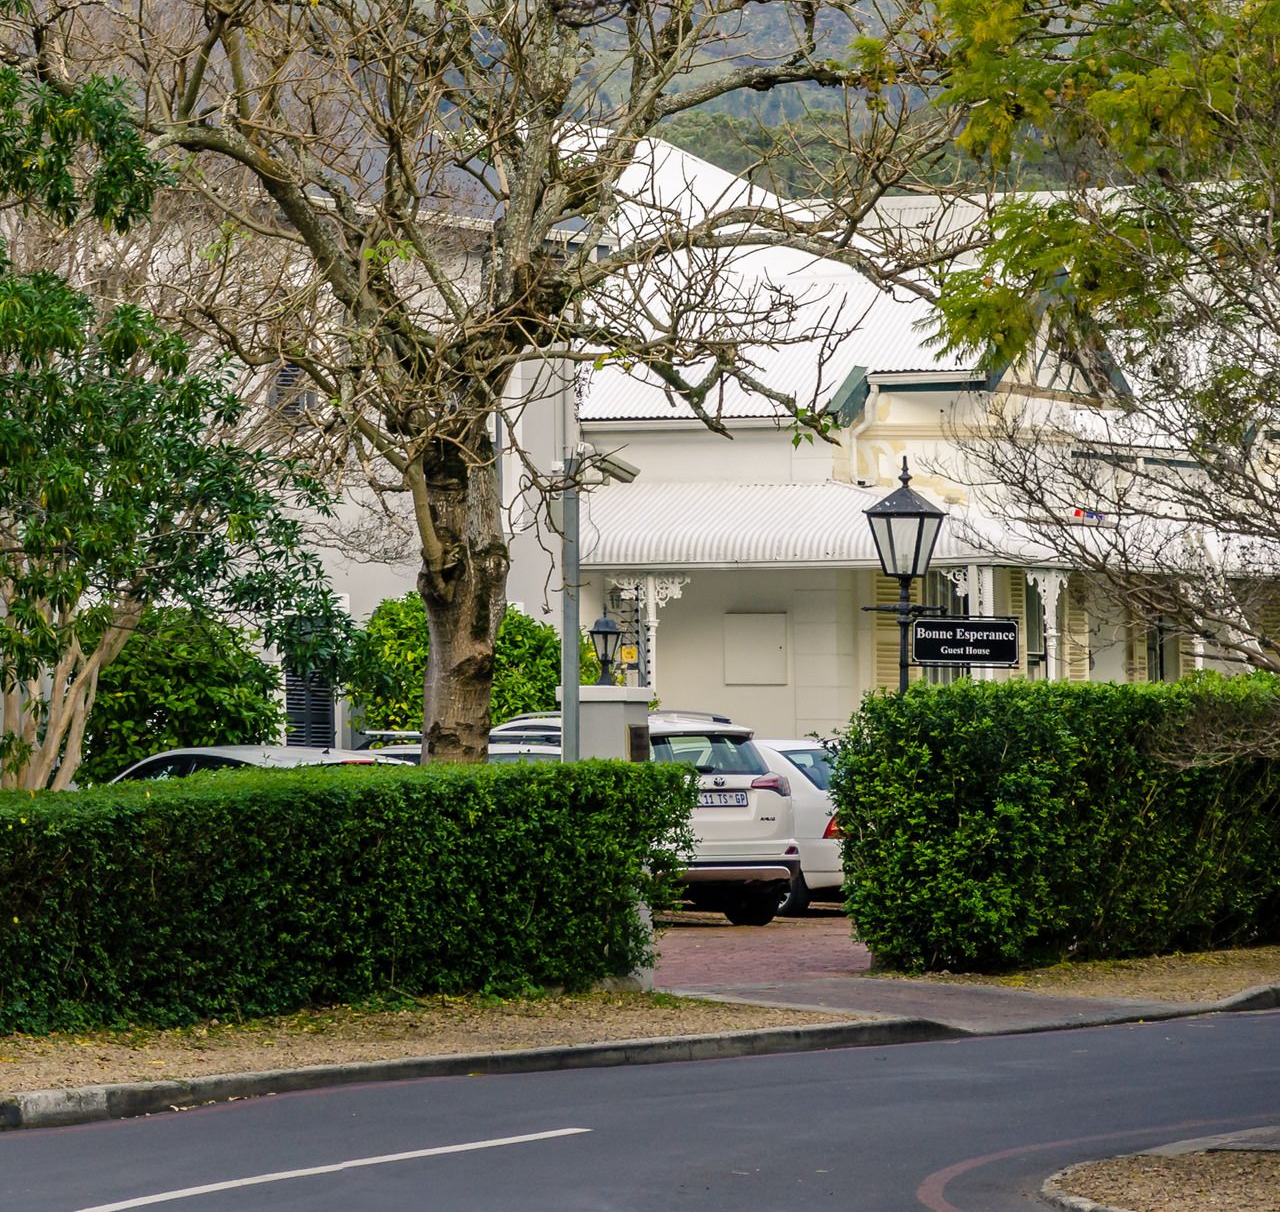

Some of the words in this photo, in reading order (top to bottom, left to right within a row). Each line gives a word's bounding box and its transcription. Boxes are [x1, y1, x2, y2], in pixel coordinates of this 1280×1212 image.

[916, 627, 953, 639] Bonne
[956, 628, 1015, 642] Esperance
[940, 646, 964, 655] Guest
[965, 646, 991, 656] House
